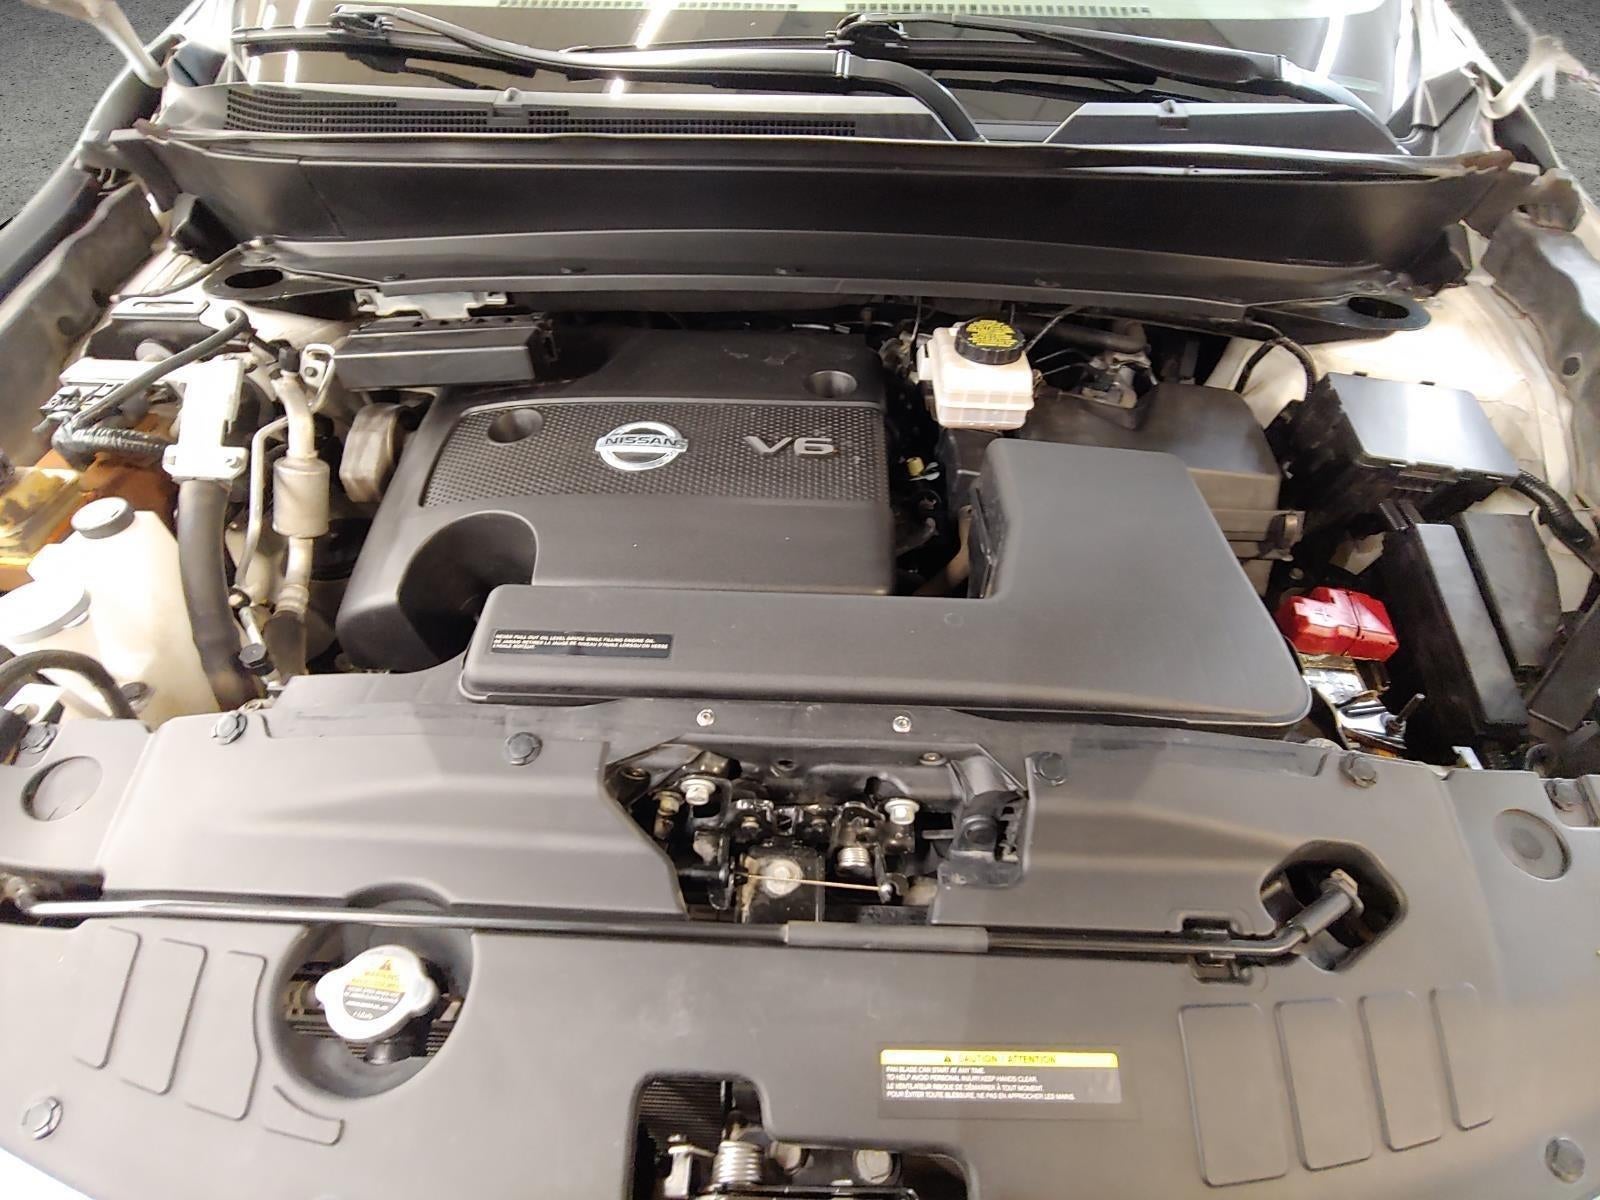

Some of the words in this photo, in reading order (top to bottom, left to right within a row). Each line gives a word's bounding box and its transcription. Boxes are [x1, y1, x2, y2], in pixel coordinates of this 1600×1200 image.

[604, 435, 680, 447] NISSAN
[743, 434, 836, 457] V6
[1008, 1055, 1056, 1064] ATTENTION
